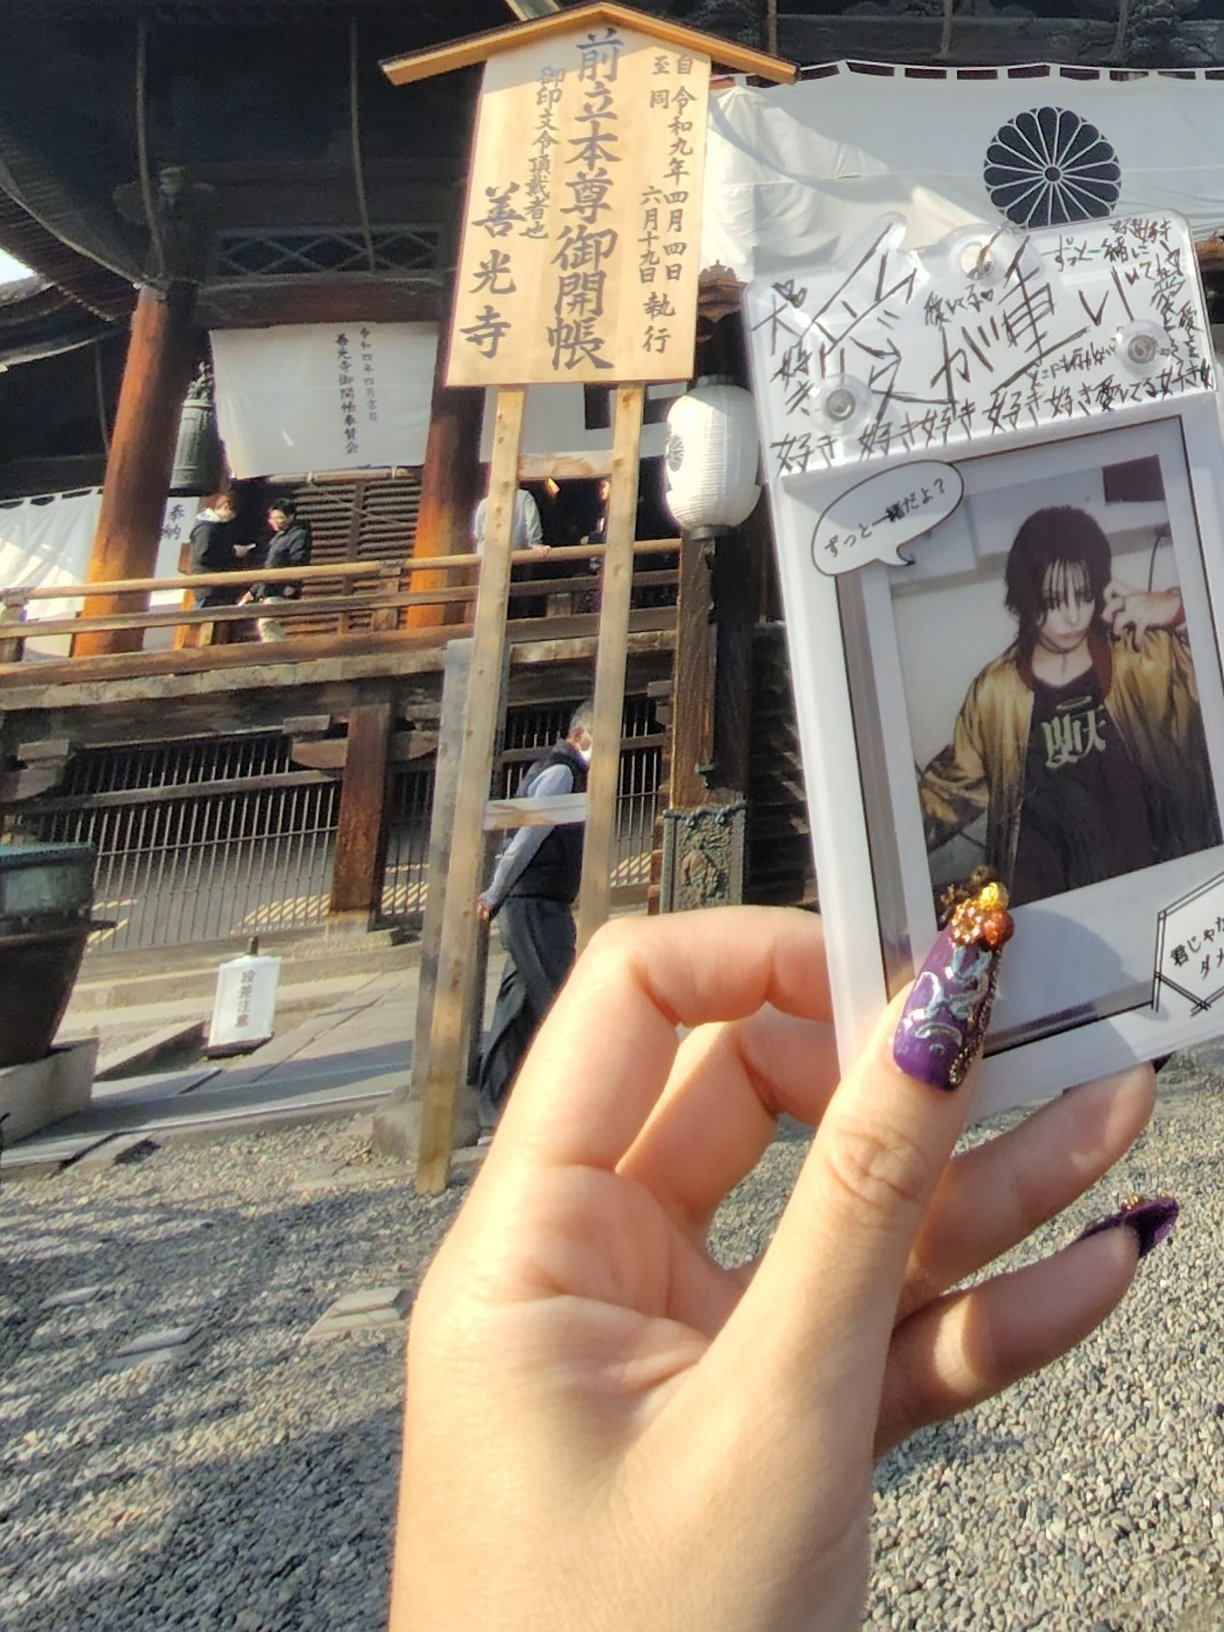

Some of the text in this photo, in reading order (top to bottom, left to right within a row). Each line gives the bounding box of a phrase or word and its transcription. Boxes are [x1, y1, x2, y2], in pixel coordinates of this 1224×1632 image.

[460, 181, 526, 360] 善光寺
[547, 27, 624, 371] 前立本尊御開帳
[642, 291, 676, 355] 執行
